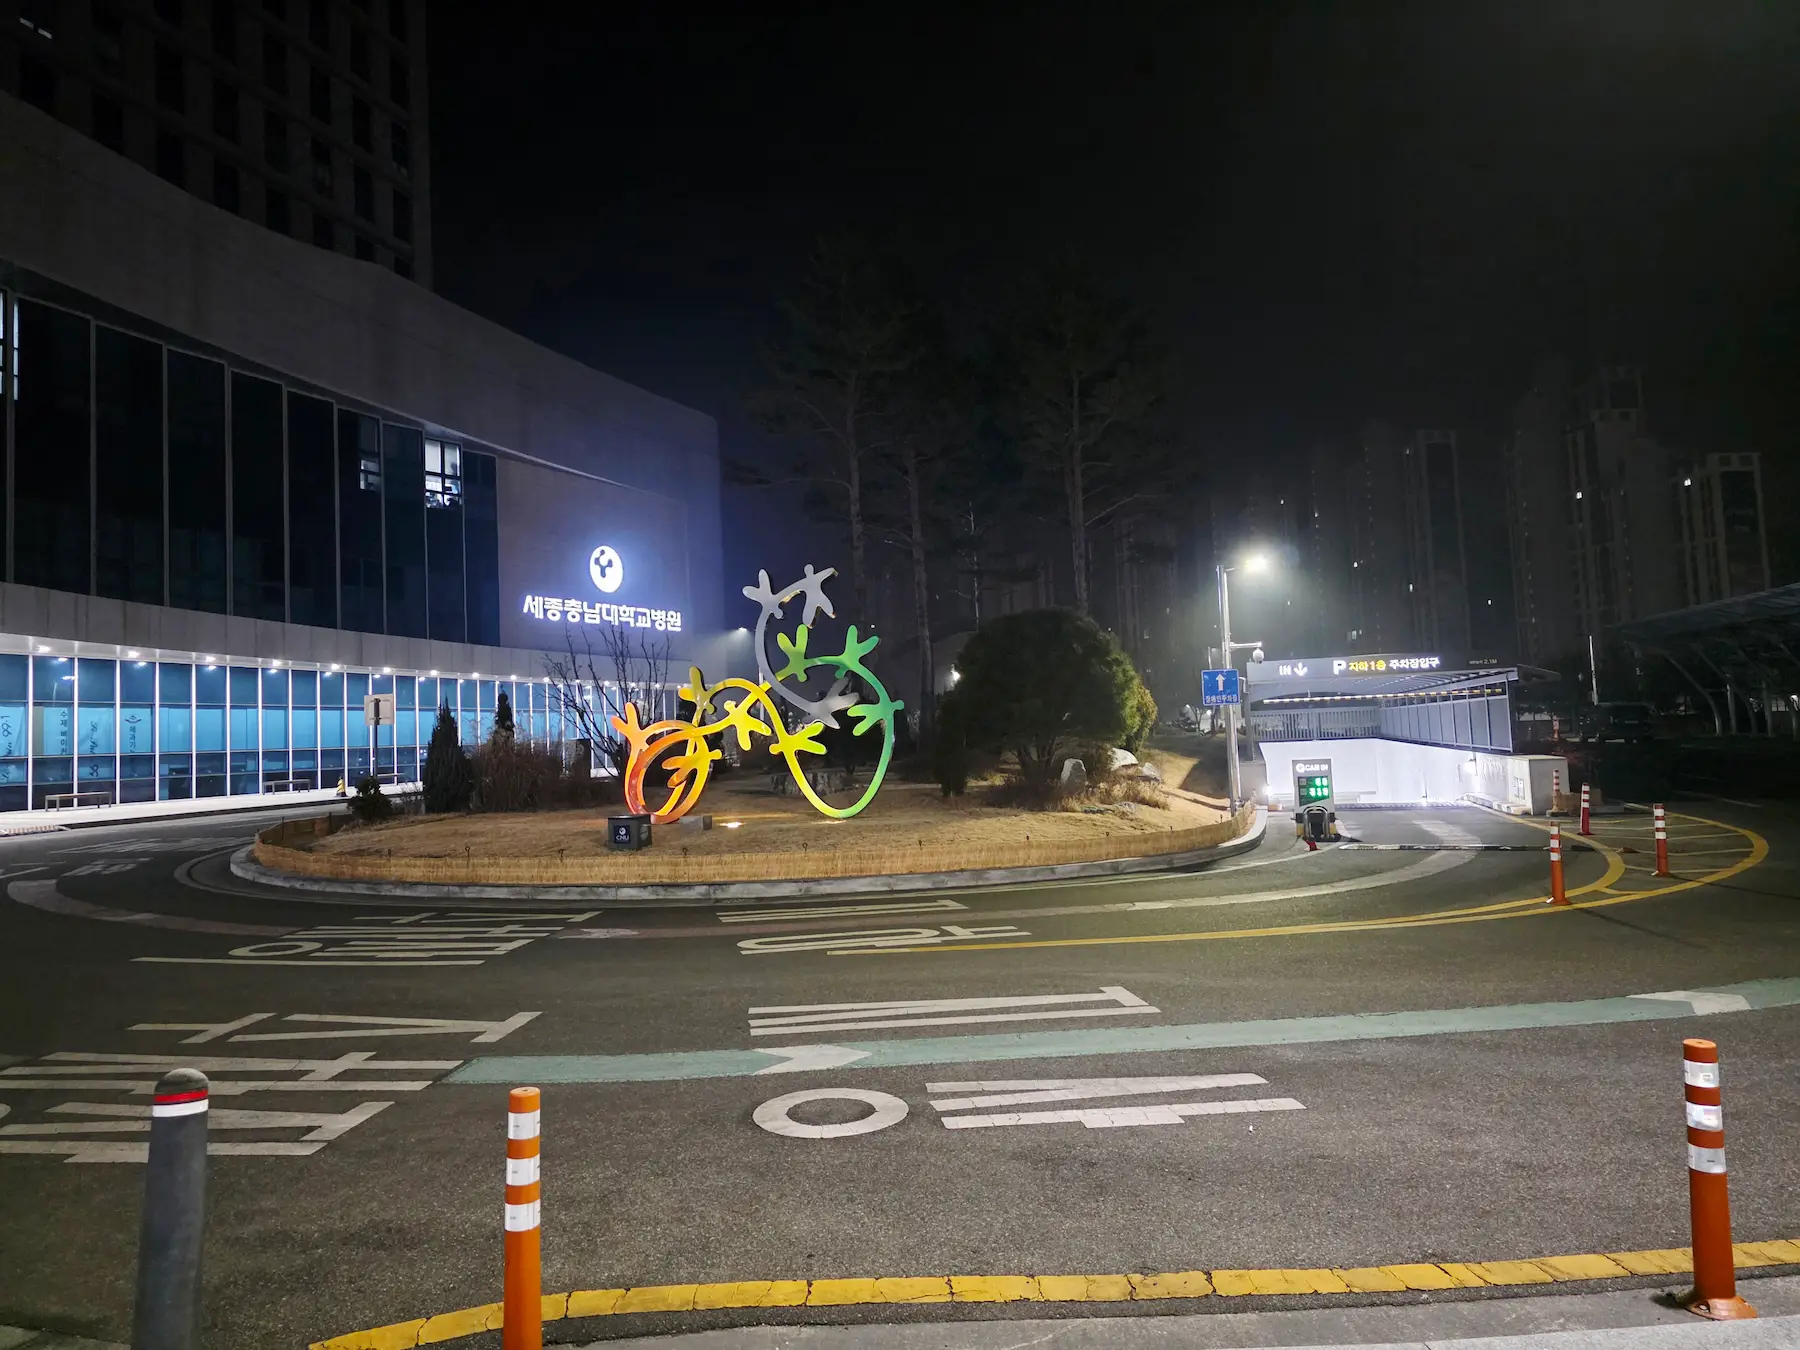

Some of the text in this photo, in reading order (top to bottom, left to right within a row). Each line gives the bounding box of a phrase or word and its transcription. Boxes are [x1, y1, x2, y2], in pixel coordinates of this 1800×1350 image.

[523, 594, 682, 632] 세종충남대학교병원
[1278, 664, 1292, 676] IN
[1333, 660, 1346, 675] P
[1389, 656, 1441, 670] 주차장입구
